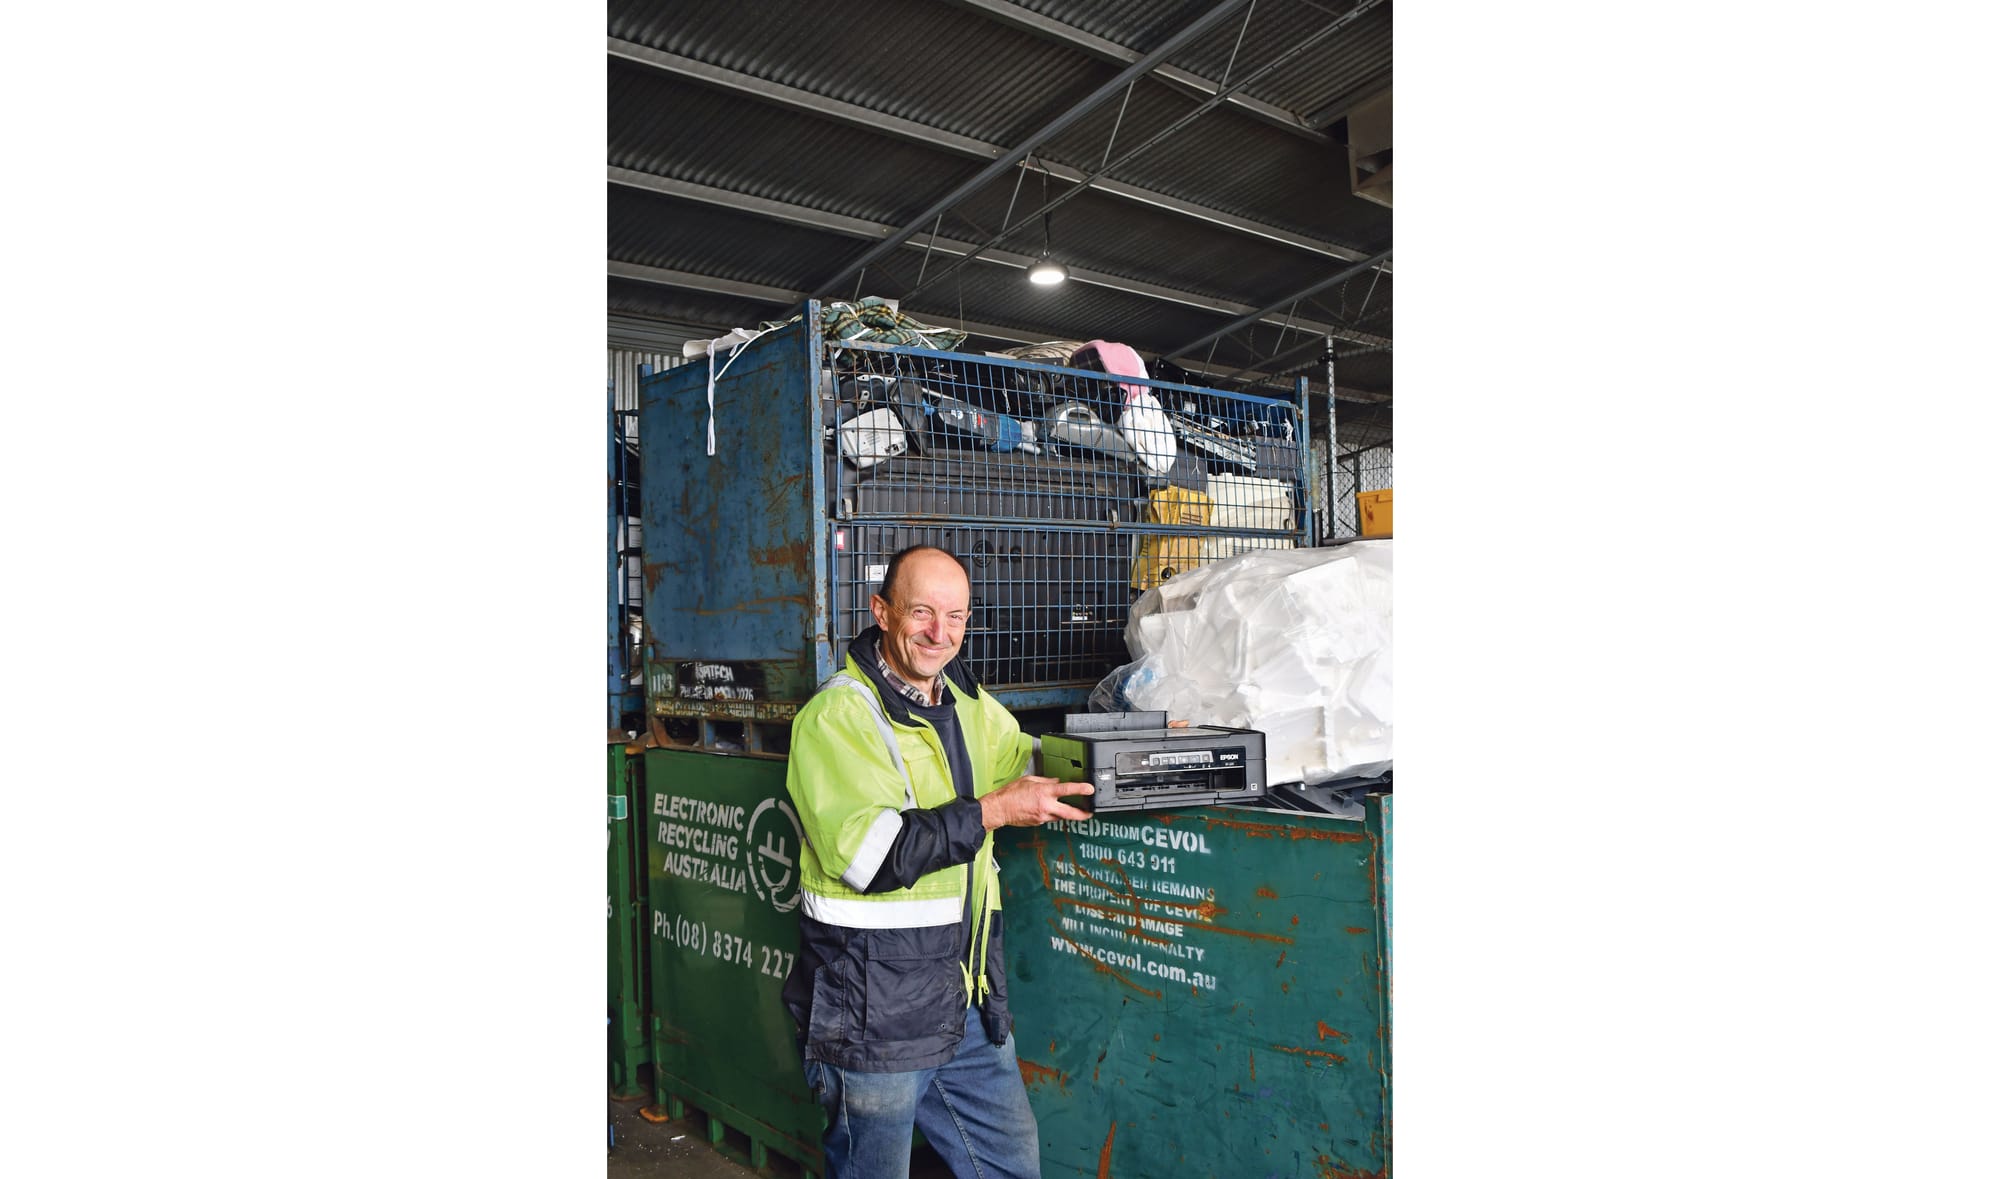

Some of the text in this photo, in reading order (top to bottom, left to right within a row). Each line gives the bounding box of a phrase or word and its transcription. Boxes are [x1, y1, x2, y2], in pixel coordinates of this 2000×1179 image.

[653, 793, 745, 831] ELECTRONIC
[657, 821, 738, 860] RECYCLING
[1047, 818, 1212, 854] HIRED FROM CEVOL
[663, 851, 747, 893] AUSTRALIA
[1079, 843, 1176, 874] 1800 643 911
[1052, 860, 1076, 877] HIS
[1152, 880, 1215, 902] REMAINS
[1054, 878, 1076, 895] THE
[1078, 883, 1141, 907] PROPERT
[1128, 914, 1184, 938] DAMAGE
[712, 930, 753, 969] 8374
[1050, 935, 1216, 991] www.cevol.com.au
